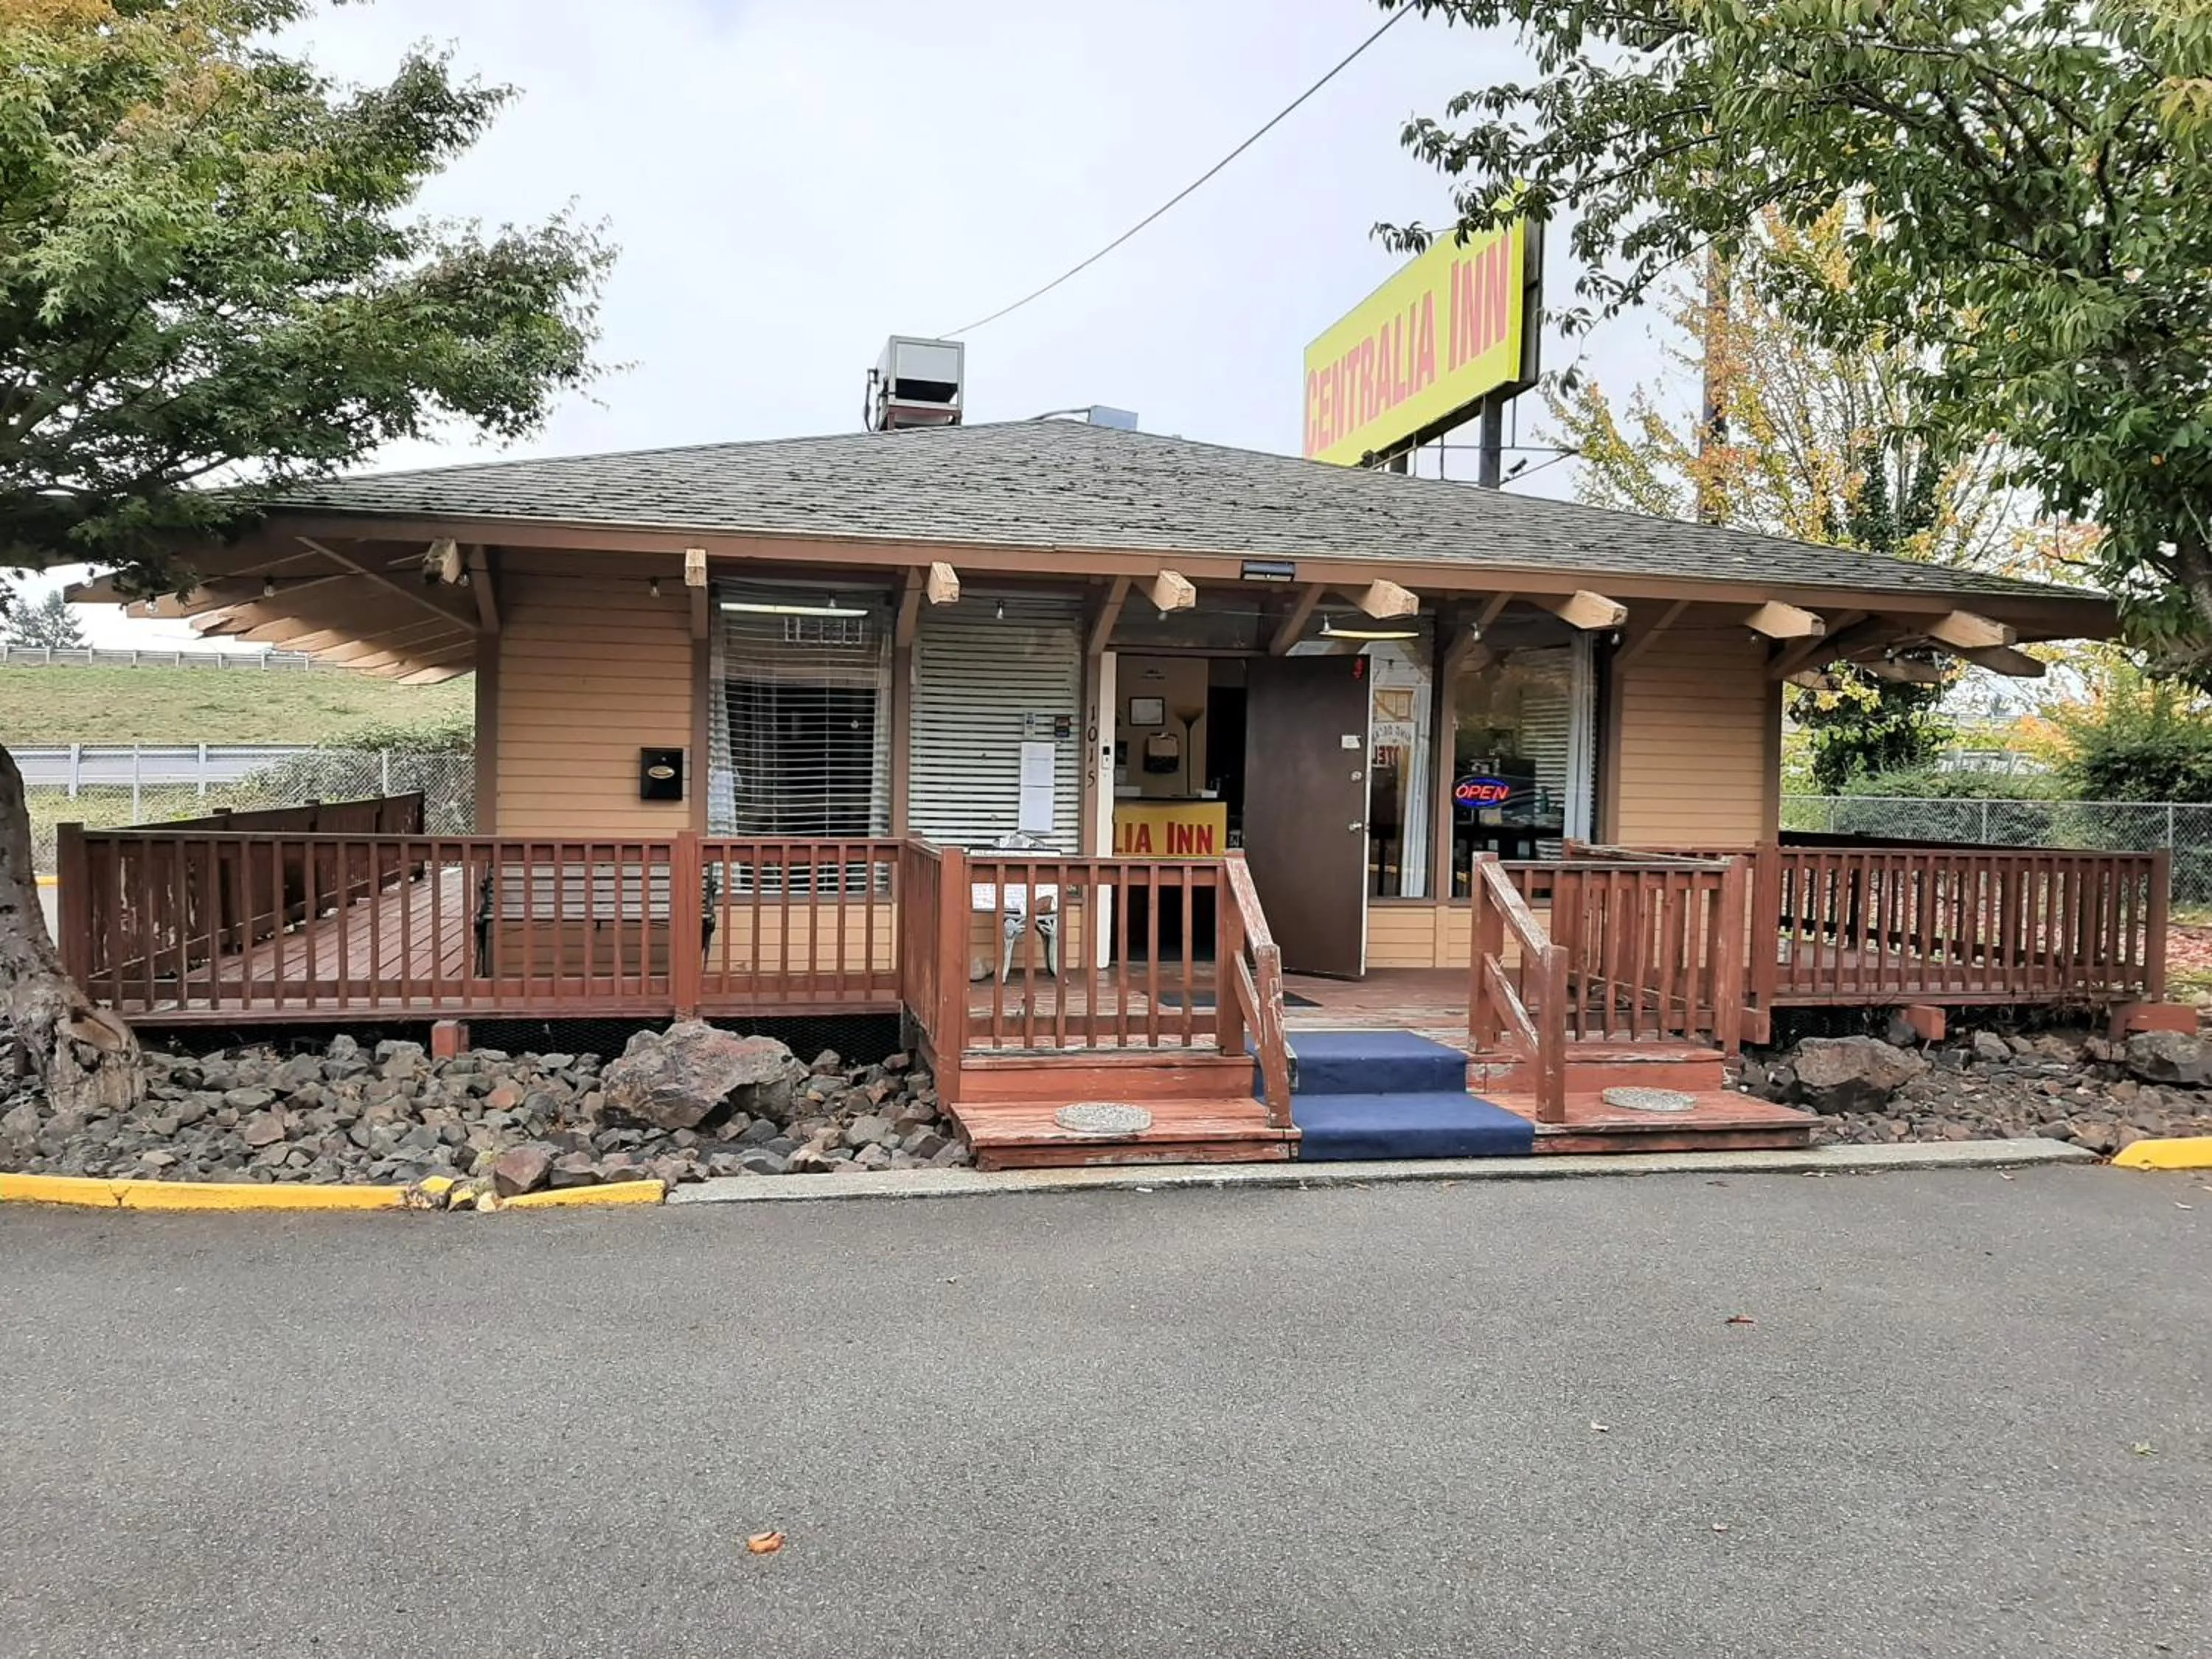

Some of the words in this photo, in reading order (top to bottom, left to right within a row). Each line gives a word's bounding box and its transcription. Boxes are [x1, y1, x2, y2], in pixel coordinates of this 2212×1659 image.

[1305, 290, 1436, 459] CENTRALIA
[1450, 233, 1509, 372] INN
[1087, 706, 1099, 788] 1015
[1455, 784, 1509, 801] OPEN
[1166, 821, 1213, 855] INN
